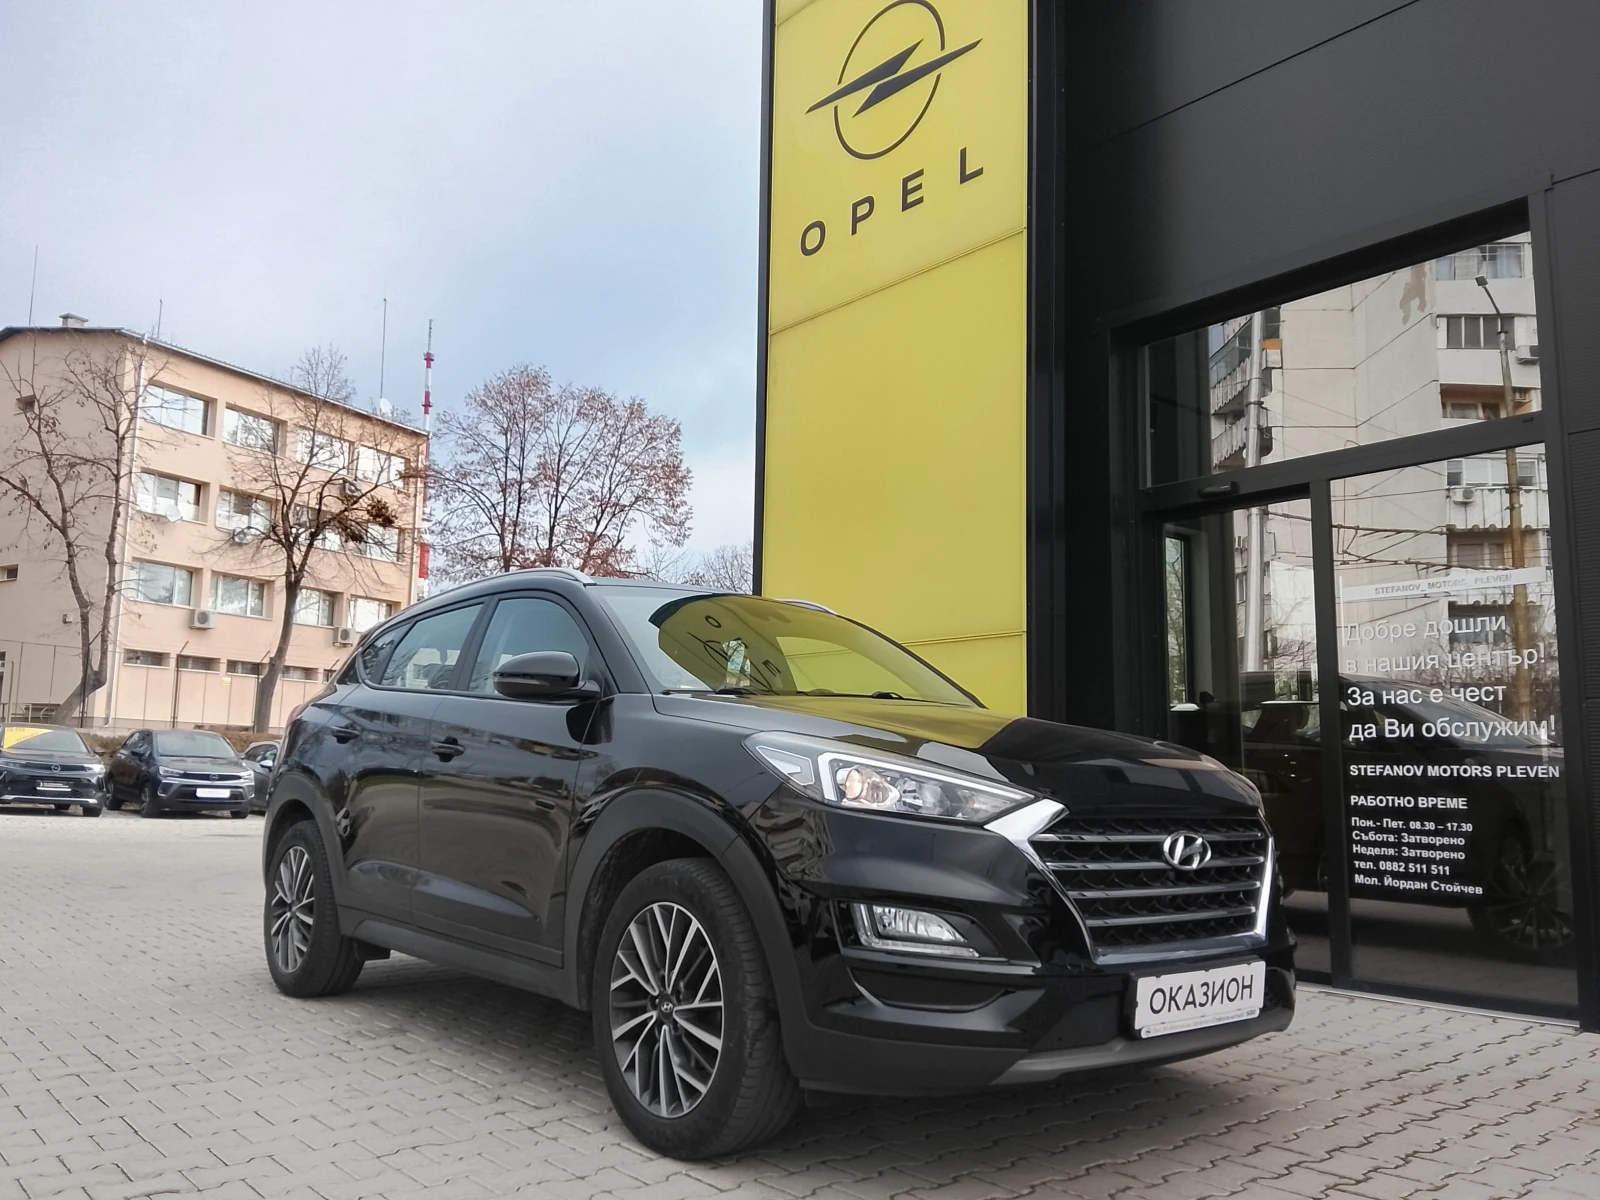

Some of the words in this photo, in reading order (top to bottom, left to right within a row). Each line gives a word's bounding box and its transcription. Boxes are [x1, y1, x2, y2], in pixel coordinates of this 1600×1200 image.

[800, 146, 983, 257] OPEL
[1346, 620, 1416, 645] Добре
[1424, 615, 1506, 640] дошли
[1346, 659, 1358, 673] в
[1365, 654, 1439, 672] нашия
[1447, 642, 1545, 670] център!
[1347, 687, 1375, 706] За
[1382, 688, 1423, 705] нас
[1429, 687, 1444, 704] е
[1451, 685, 1507, 703] чест
[1349, 722, 1377, 742] да
[1384, 718, 1415, 738] Ви
[1421, 715, 1556, 742] обслужим!
[1349, 764, 1424, 777] STEFANOV
[1427, 765, 1493, 778] MOTORS
[1496, 765, 1560, 778] PLEVEN
[1350, 795, 1415, 808] РАБОТНО
[1418, 797, 1468, 809] ВРЕМЕ
[1383, 818, 1406, 829] Пет.
[1409, 821, 1436, 831] 08.30
[1446, 822, 1473, 832] 17.30
[1352, 830, 1399, 842] Събота:
[1400, 832, 1466, 846] Затворено
[1352, 844, 1399, 856] Неделя:
[1400, 846, 1466, 860] Затворено
[1353, 860, 1377, 870] тел.
[1379, 861, 1406, 872] 0882
[1408, 863, 1427, 873] 511
[1430, 864, 1450, 876] 511
[1383, 874, 1428, 890] Йордан
[1430, 880, 1483, 895] Стойчев
[1149, 974, 1254, 1015] ОКАЗИОН
